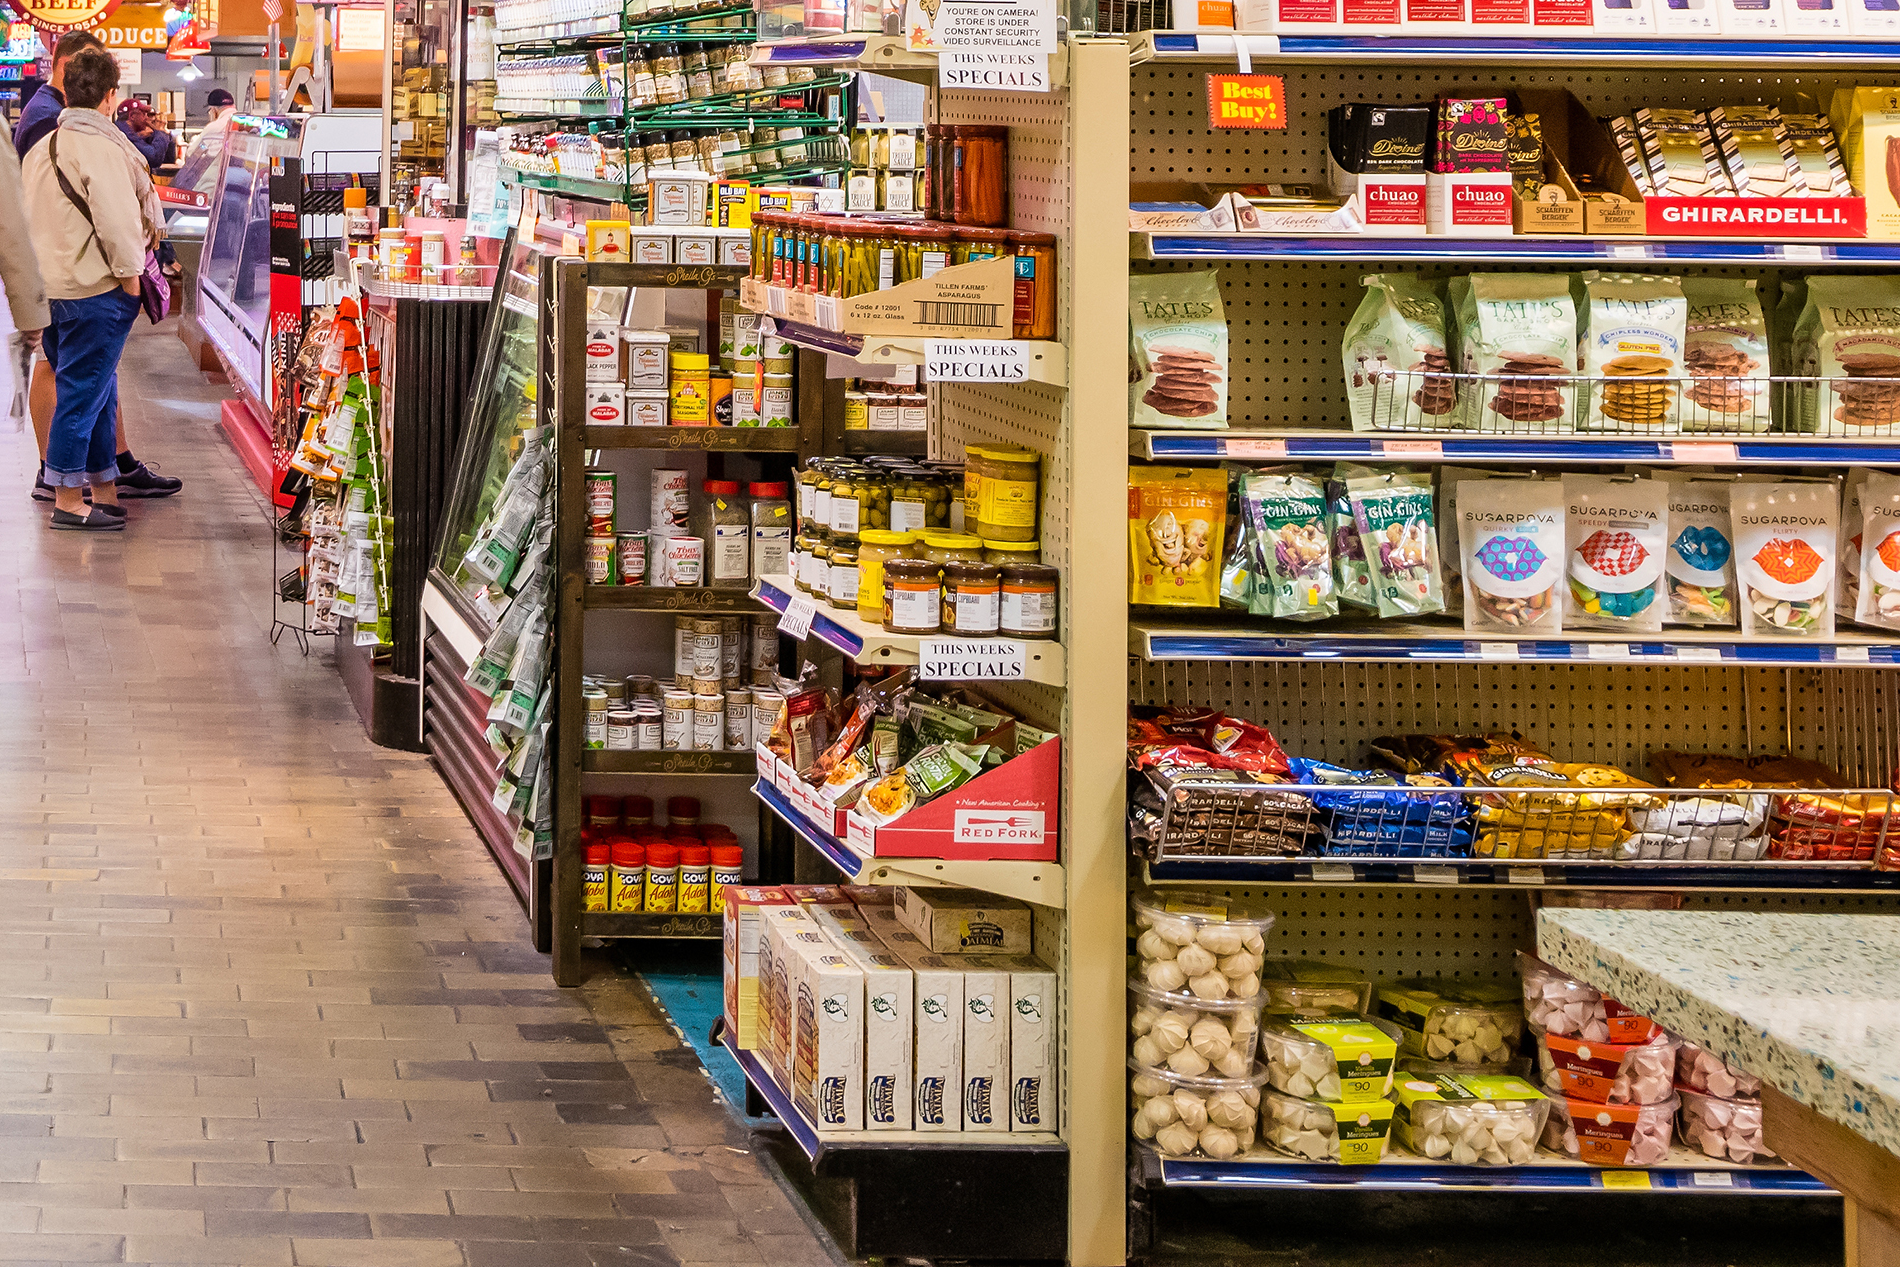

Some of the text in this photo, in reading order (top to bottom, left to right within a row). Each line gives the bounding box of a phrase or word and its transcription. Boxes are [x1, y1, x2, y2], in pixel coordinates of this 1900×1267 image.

[946, 8, 1039, 17] YOU'RE ON CAMERA!
[955, 18, 1029, 27] STORE IS UNDER
[944, 27, 1041, 38] CONSTANT SECURITY
[943, 37, 1042, 47] VIDEO SURVEILLANCE
[953, 53, 1036, 66] THIS WEEKS
[947, 69, 1042, 87] SPECIALS
[1221, 81, 1274, 99] Best
[1220, 101, 1276, 122] Buy!
[937, 291, 982, 300] ASPARAGUS
[1138, 300, 1215, 316] TATE'S
[1465, 511, 1556, 525] SUGARPOVA
[961, 827, 1040, 838] RED FORK
